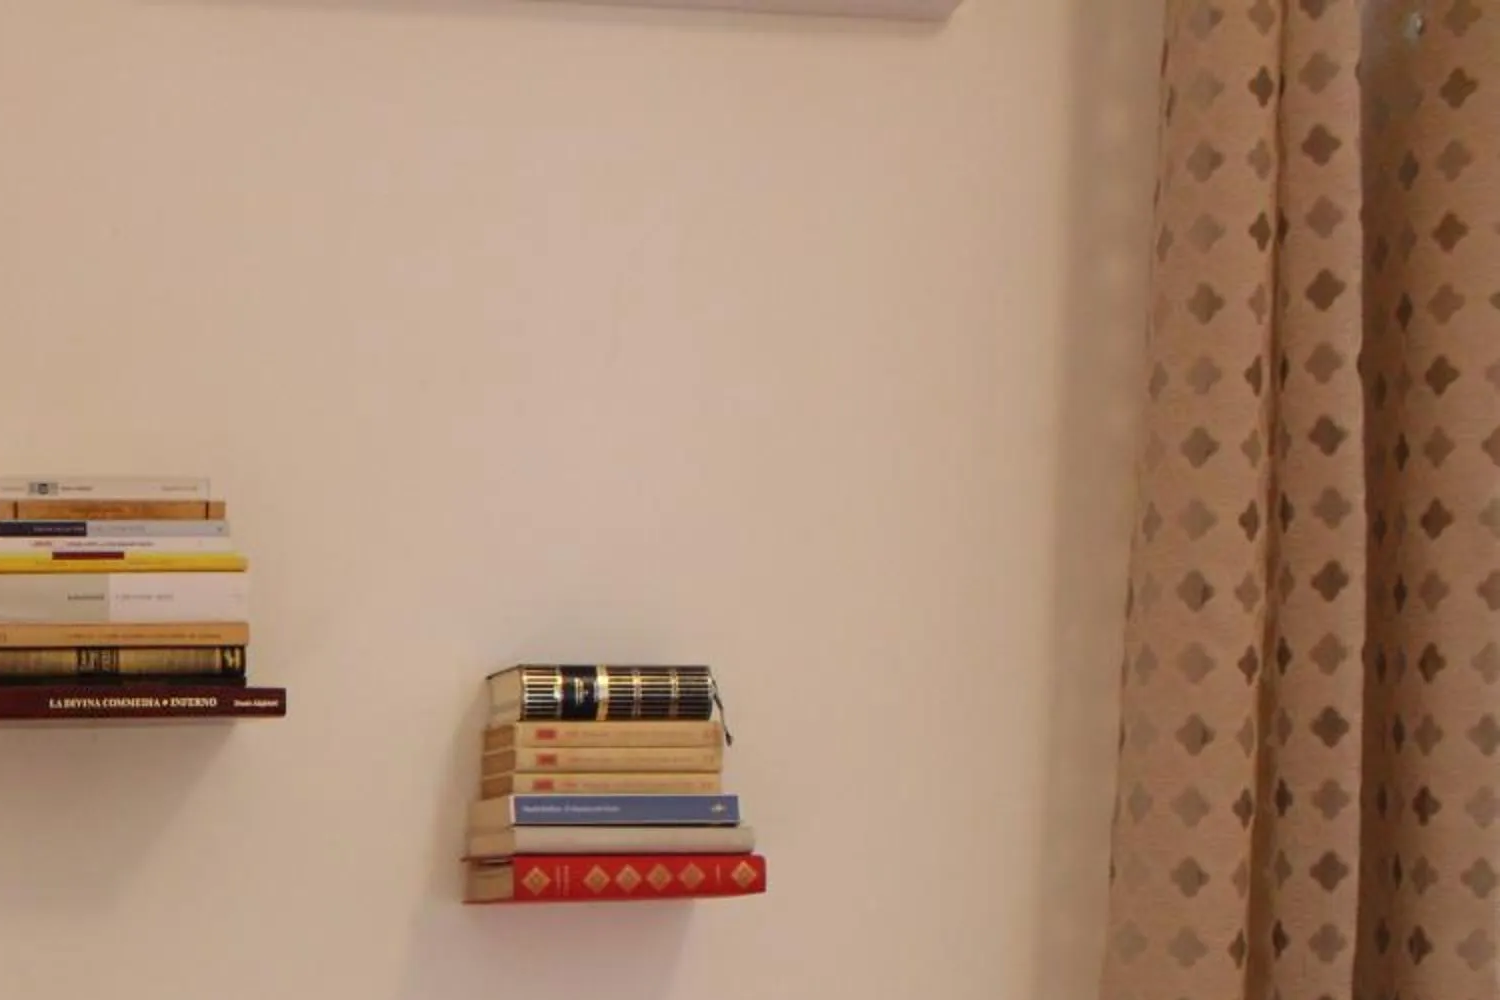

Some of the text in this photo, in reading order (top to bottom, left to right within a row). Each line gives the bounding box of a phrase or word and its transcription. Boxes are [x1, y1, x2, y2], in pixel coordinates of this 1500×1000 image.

[49, 697, 218, 708] LA DIVINA COMMEDIA INFERNO
